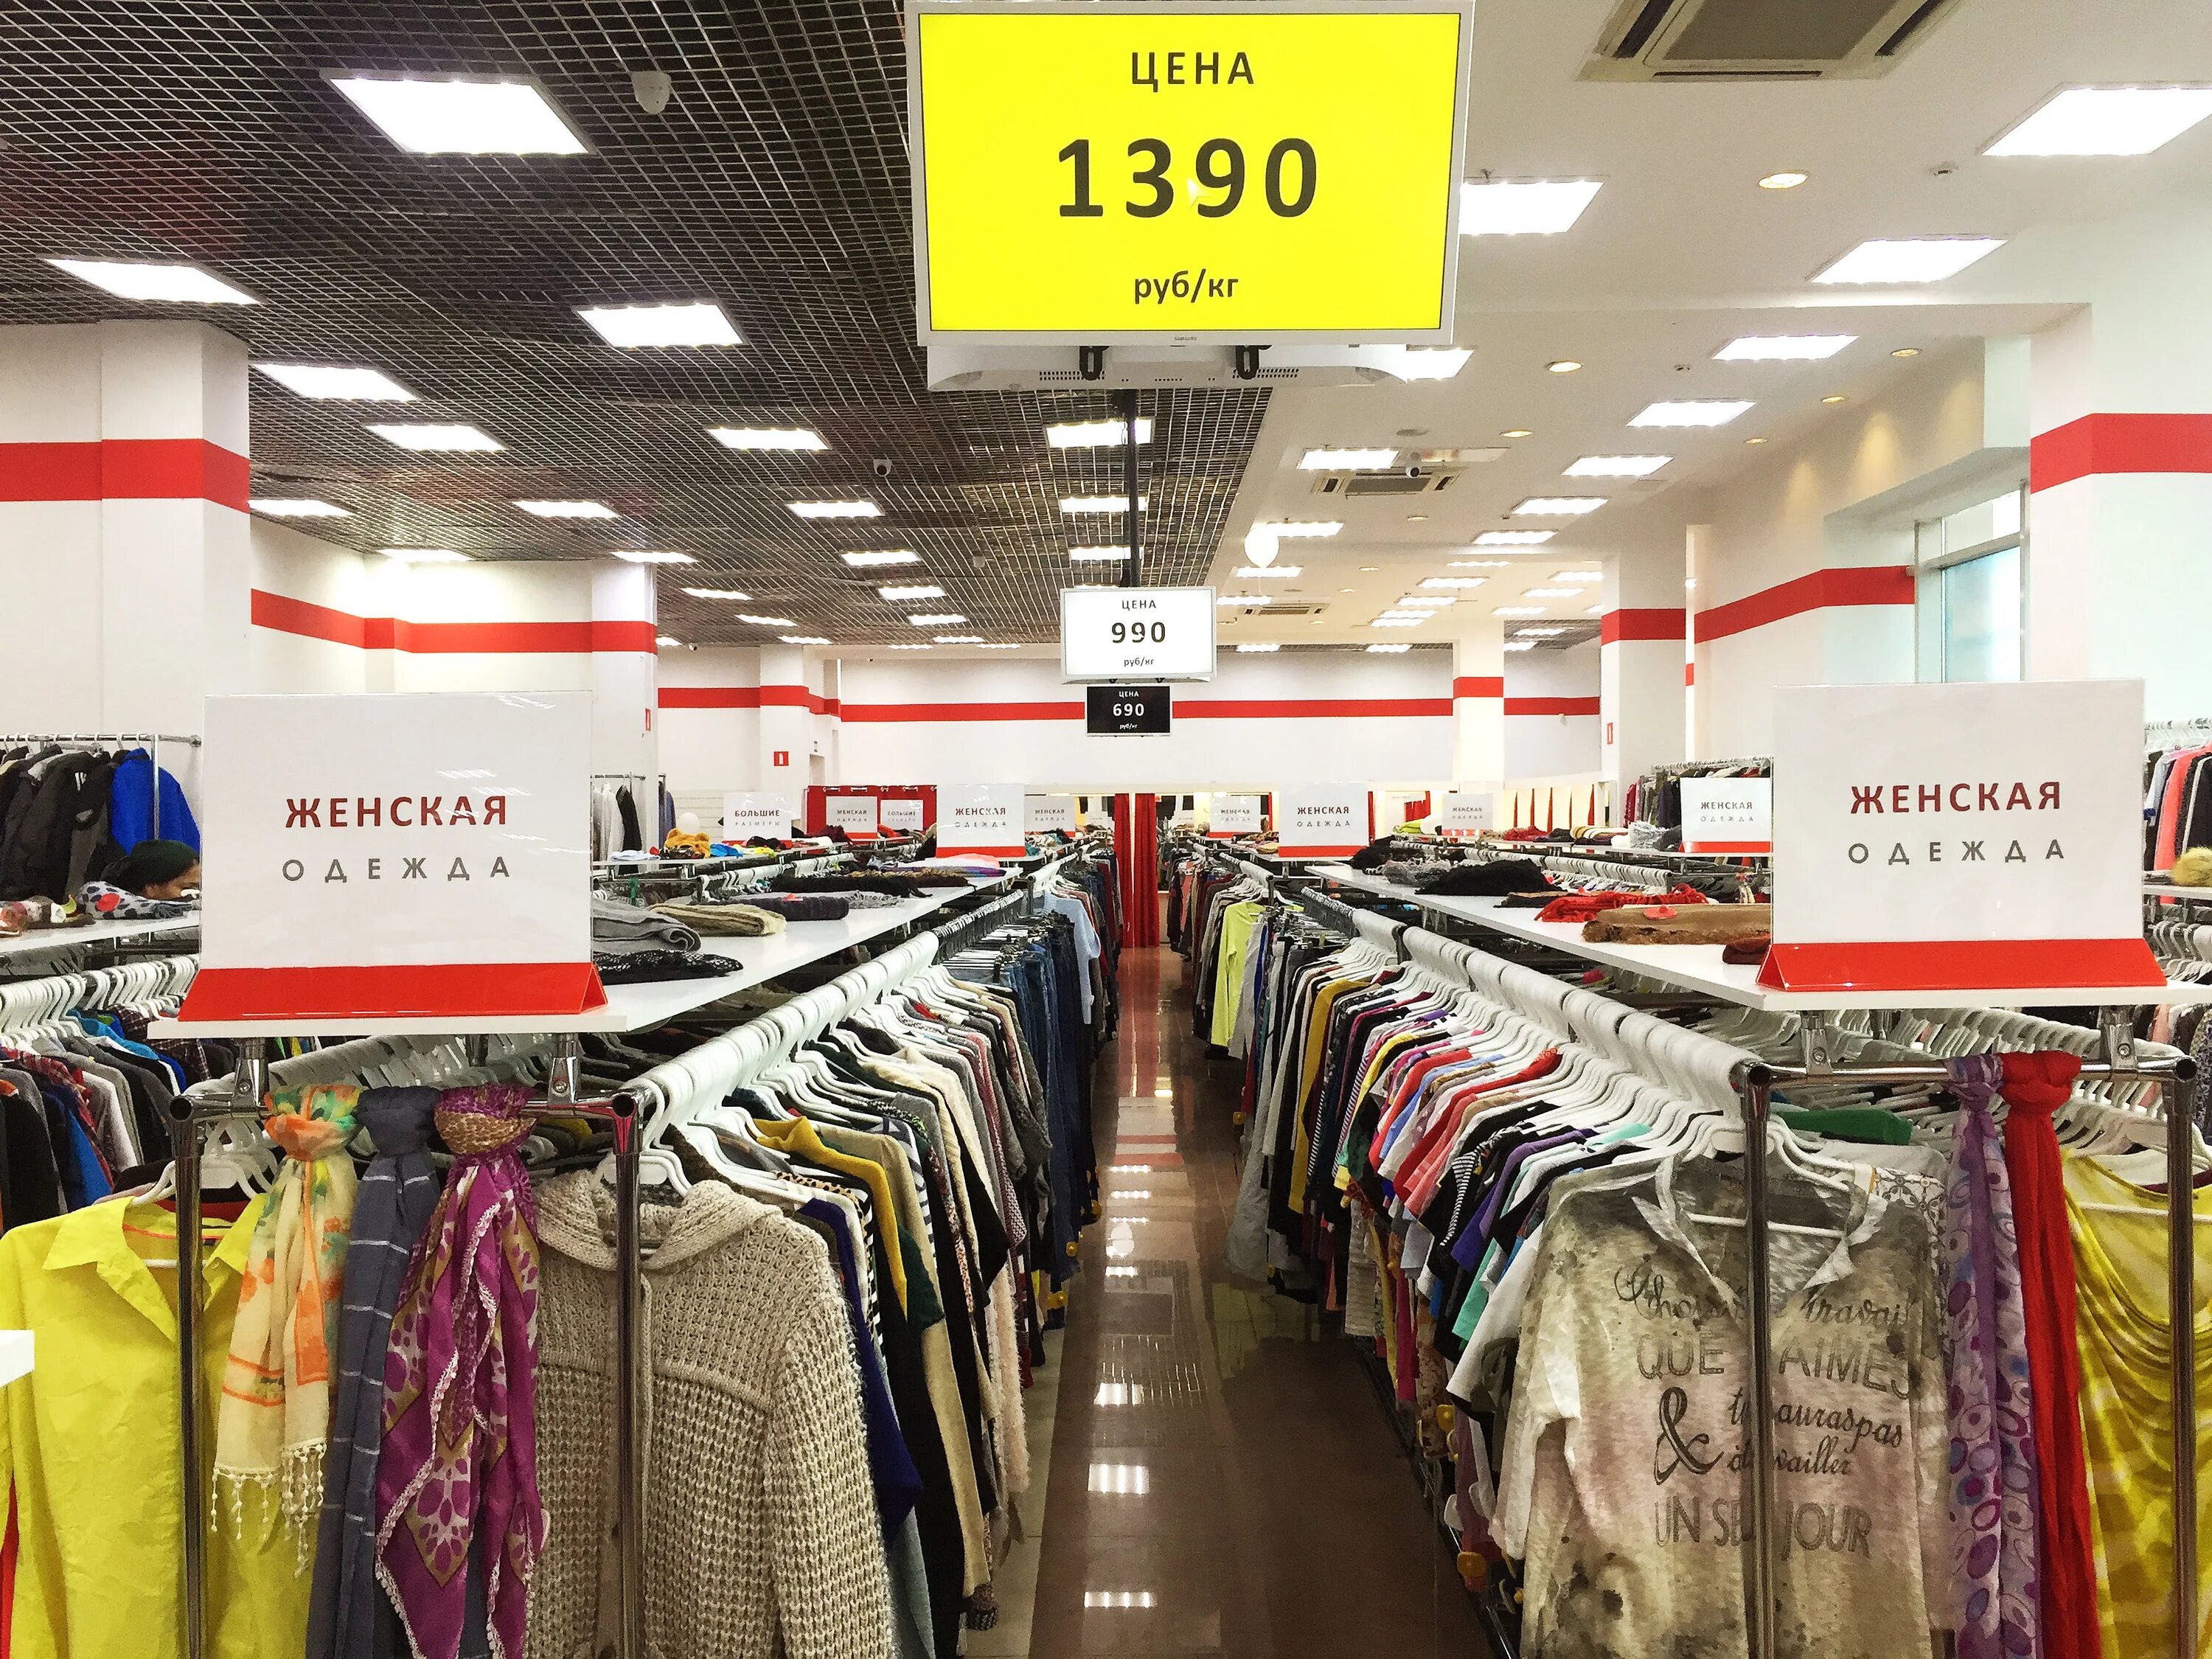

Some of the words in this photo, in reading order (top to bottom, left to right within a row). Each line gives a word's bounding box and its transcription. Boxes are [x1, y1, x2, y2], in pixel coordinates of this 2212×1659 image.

[1131, 51, 1255, 93] ЦЕНА
[1058, 137, 1318, 219] 1390
[1134, 268, 1239, 305] руб/кг
[1121, 599, 1157, 611] ЦЕНА
[1111, 622, 1166, 644] 990
[1124, 657, 1155, 667] руб/кг
[1113, 703, 1145, 717] 690
[955, 807, 1006, 816] ЖЕНСКАЯ
[1297, 806, 1350, 815] ЖЕНСКАЯ
[1700, 801, 1753, 810] ЖЕНСКАЯ
[1850, 782, 2060, 814] ЖЕНСКАЯ
[285, 796, 507, 828] ЖЕНСКАЯ
[734, 809, 781, 818] БОЛЬШИЕ
[1297, 820, 1351, 828] ОДЕЖДА
[1848, 839, 2065, 866] ОДЕЖДА
[282, 856, 510, 883] ОДЕЖДА
[1636, 1331, 1725, 1381] QUE
[1654, 1386, 1725, 1486] &
[1654, 1495, 1700, 1548] UN
[1781, 1501, 1874, 1562] JOUR
